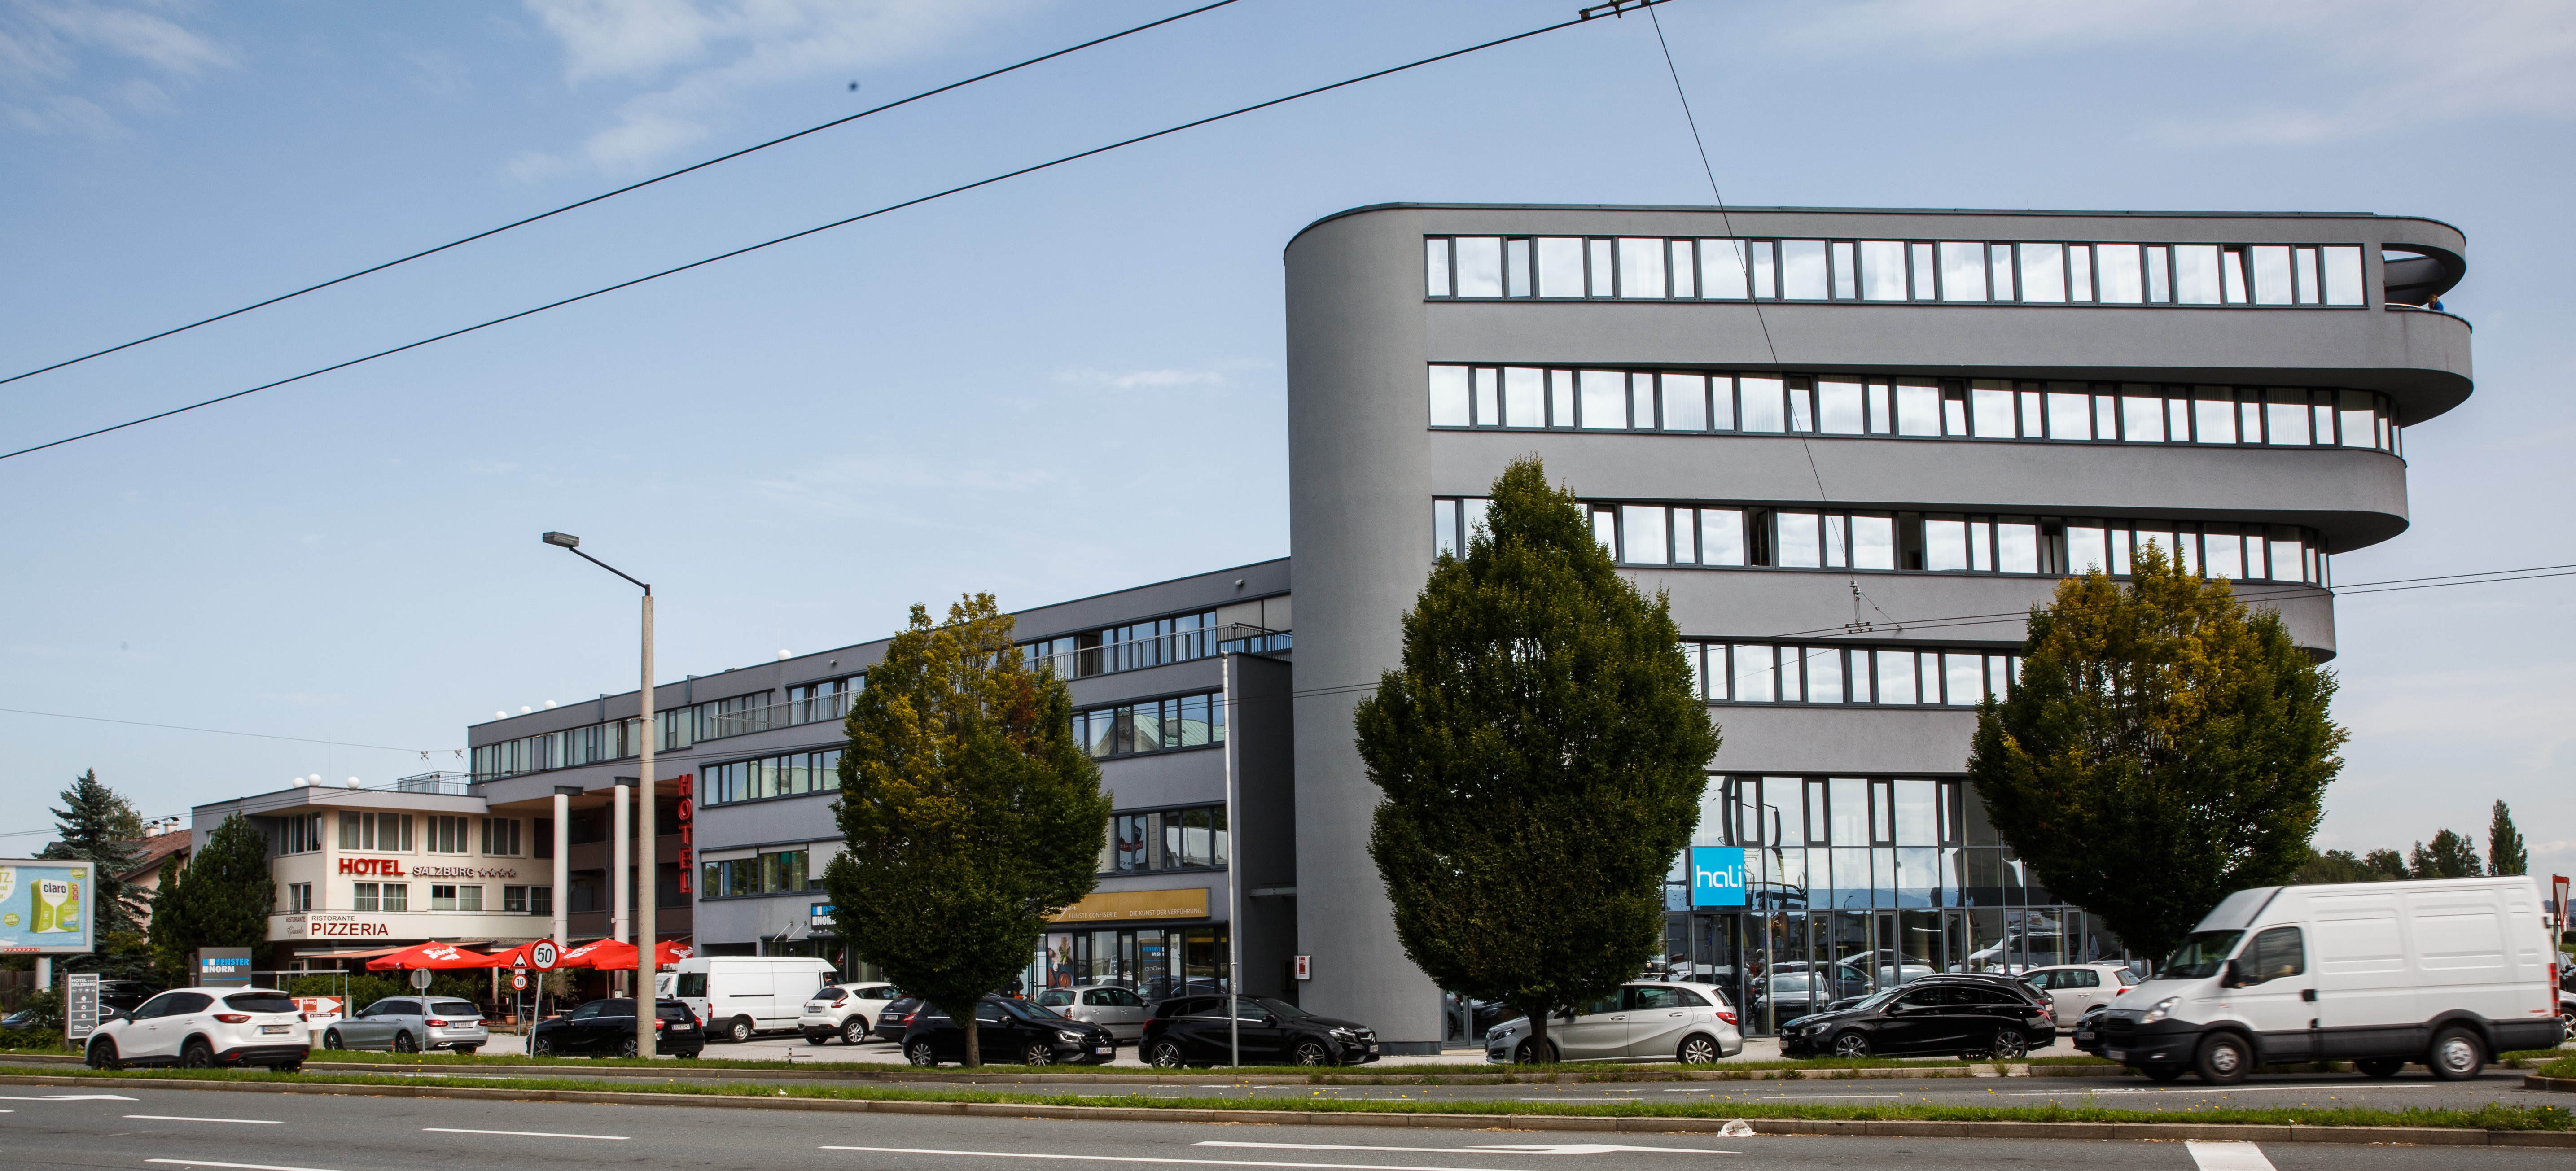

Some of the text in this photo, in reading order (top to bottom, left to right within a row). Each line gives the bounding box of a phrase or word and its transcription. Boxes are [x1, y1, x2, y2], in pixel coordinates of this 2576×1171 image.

[679, 774, 693, 893] HOTEL
[339, 858, 474, 877] HOTEL SALZBURG
[1696, 865, 1742, 887] hali
[44, 883, 66, 893] claro
[312, 923, 389, 936] PIZZERIA
[537, 948, 552, 963] 50
